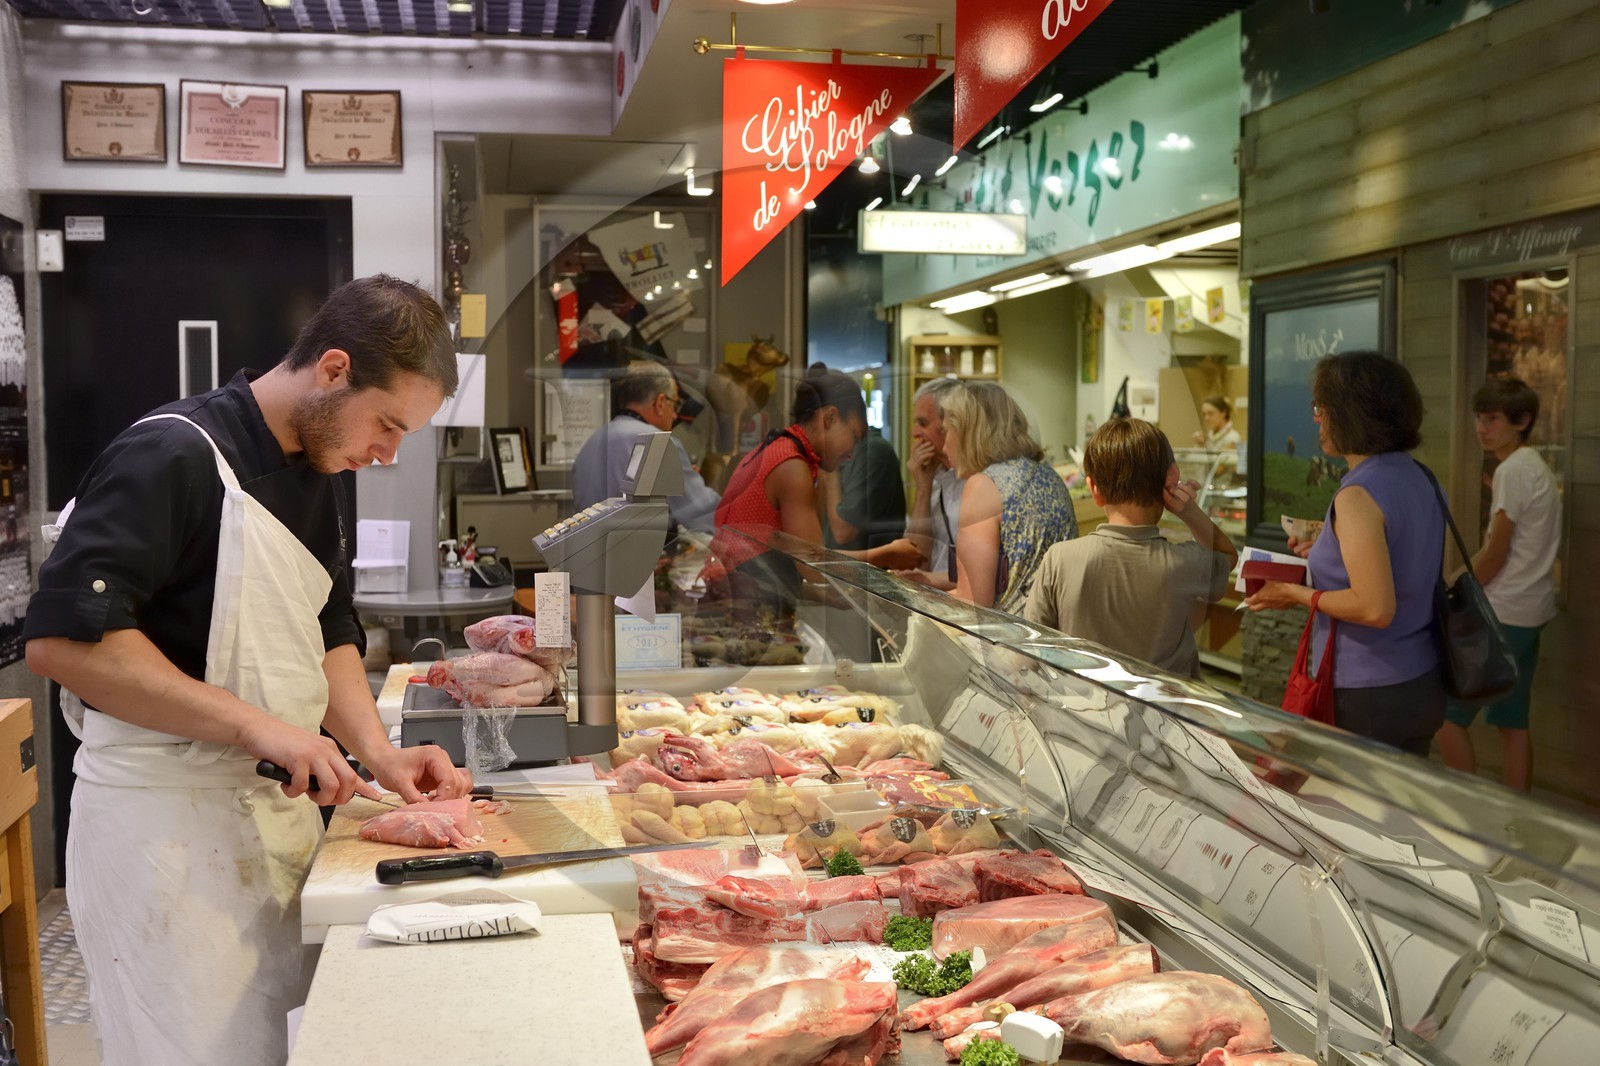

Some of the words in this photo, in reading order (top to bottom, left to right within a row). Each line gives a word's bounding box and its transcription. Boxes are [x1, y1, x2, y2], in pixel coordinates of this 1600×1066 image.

[742, 79, 842, 172] Gibier
[784, 88, 892, 195] Sologne
[753, 181, 780, 231] de
[635, 637, 658, 647] 2013
[397, 914, 517, 944] TROLLIE
